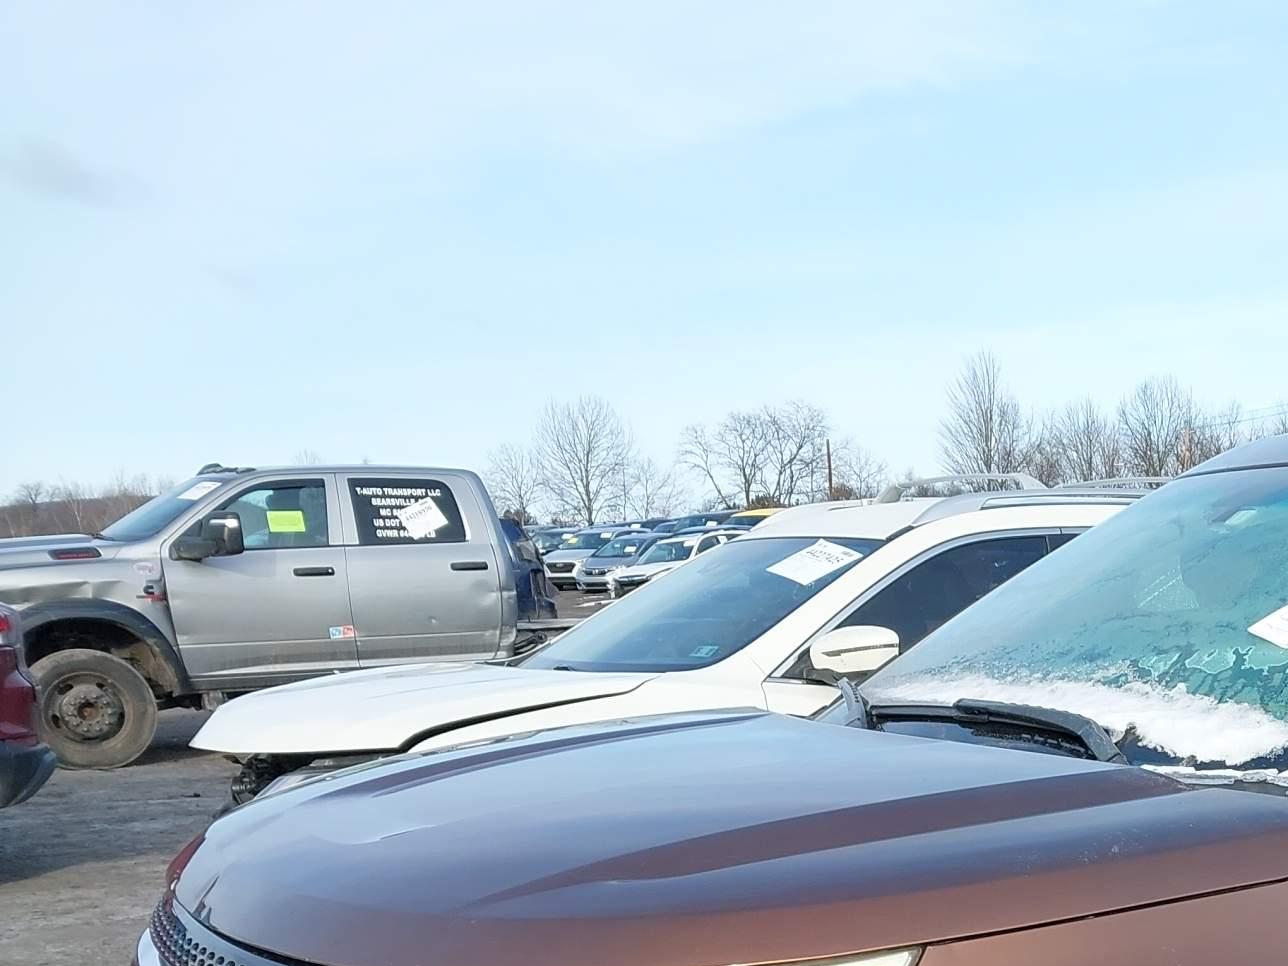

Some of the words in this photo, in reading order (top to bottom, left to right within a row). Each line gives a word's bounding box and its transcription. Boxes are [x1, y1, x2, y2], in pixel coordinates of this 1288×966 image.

[355, 487, 383, 495] T-AUTO
[383, 487, 426, 496] TRANSPORT
[427, 488, 441, 496] LLC
[379, 508, 392, 516] MC
[373, 518, 384, 527] US
[385, 518, 400, 527] DOT
[376, 529, 399, 538] GVWR
